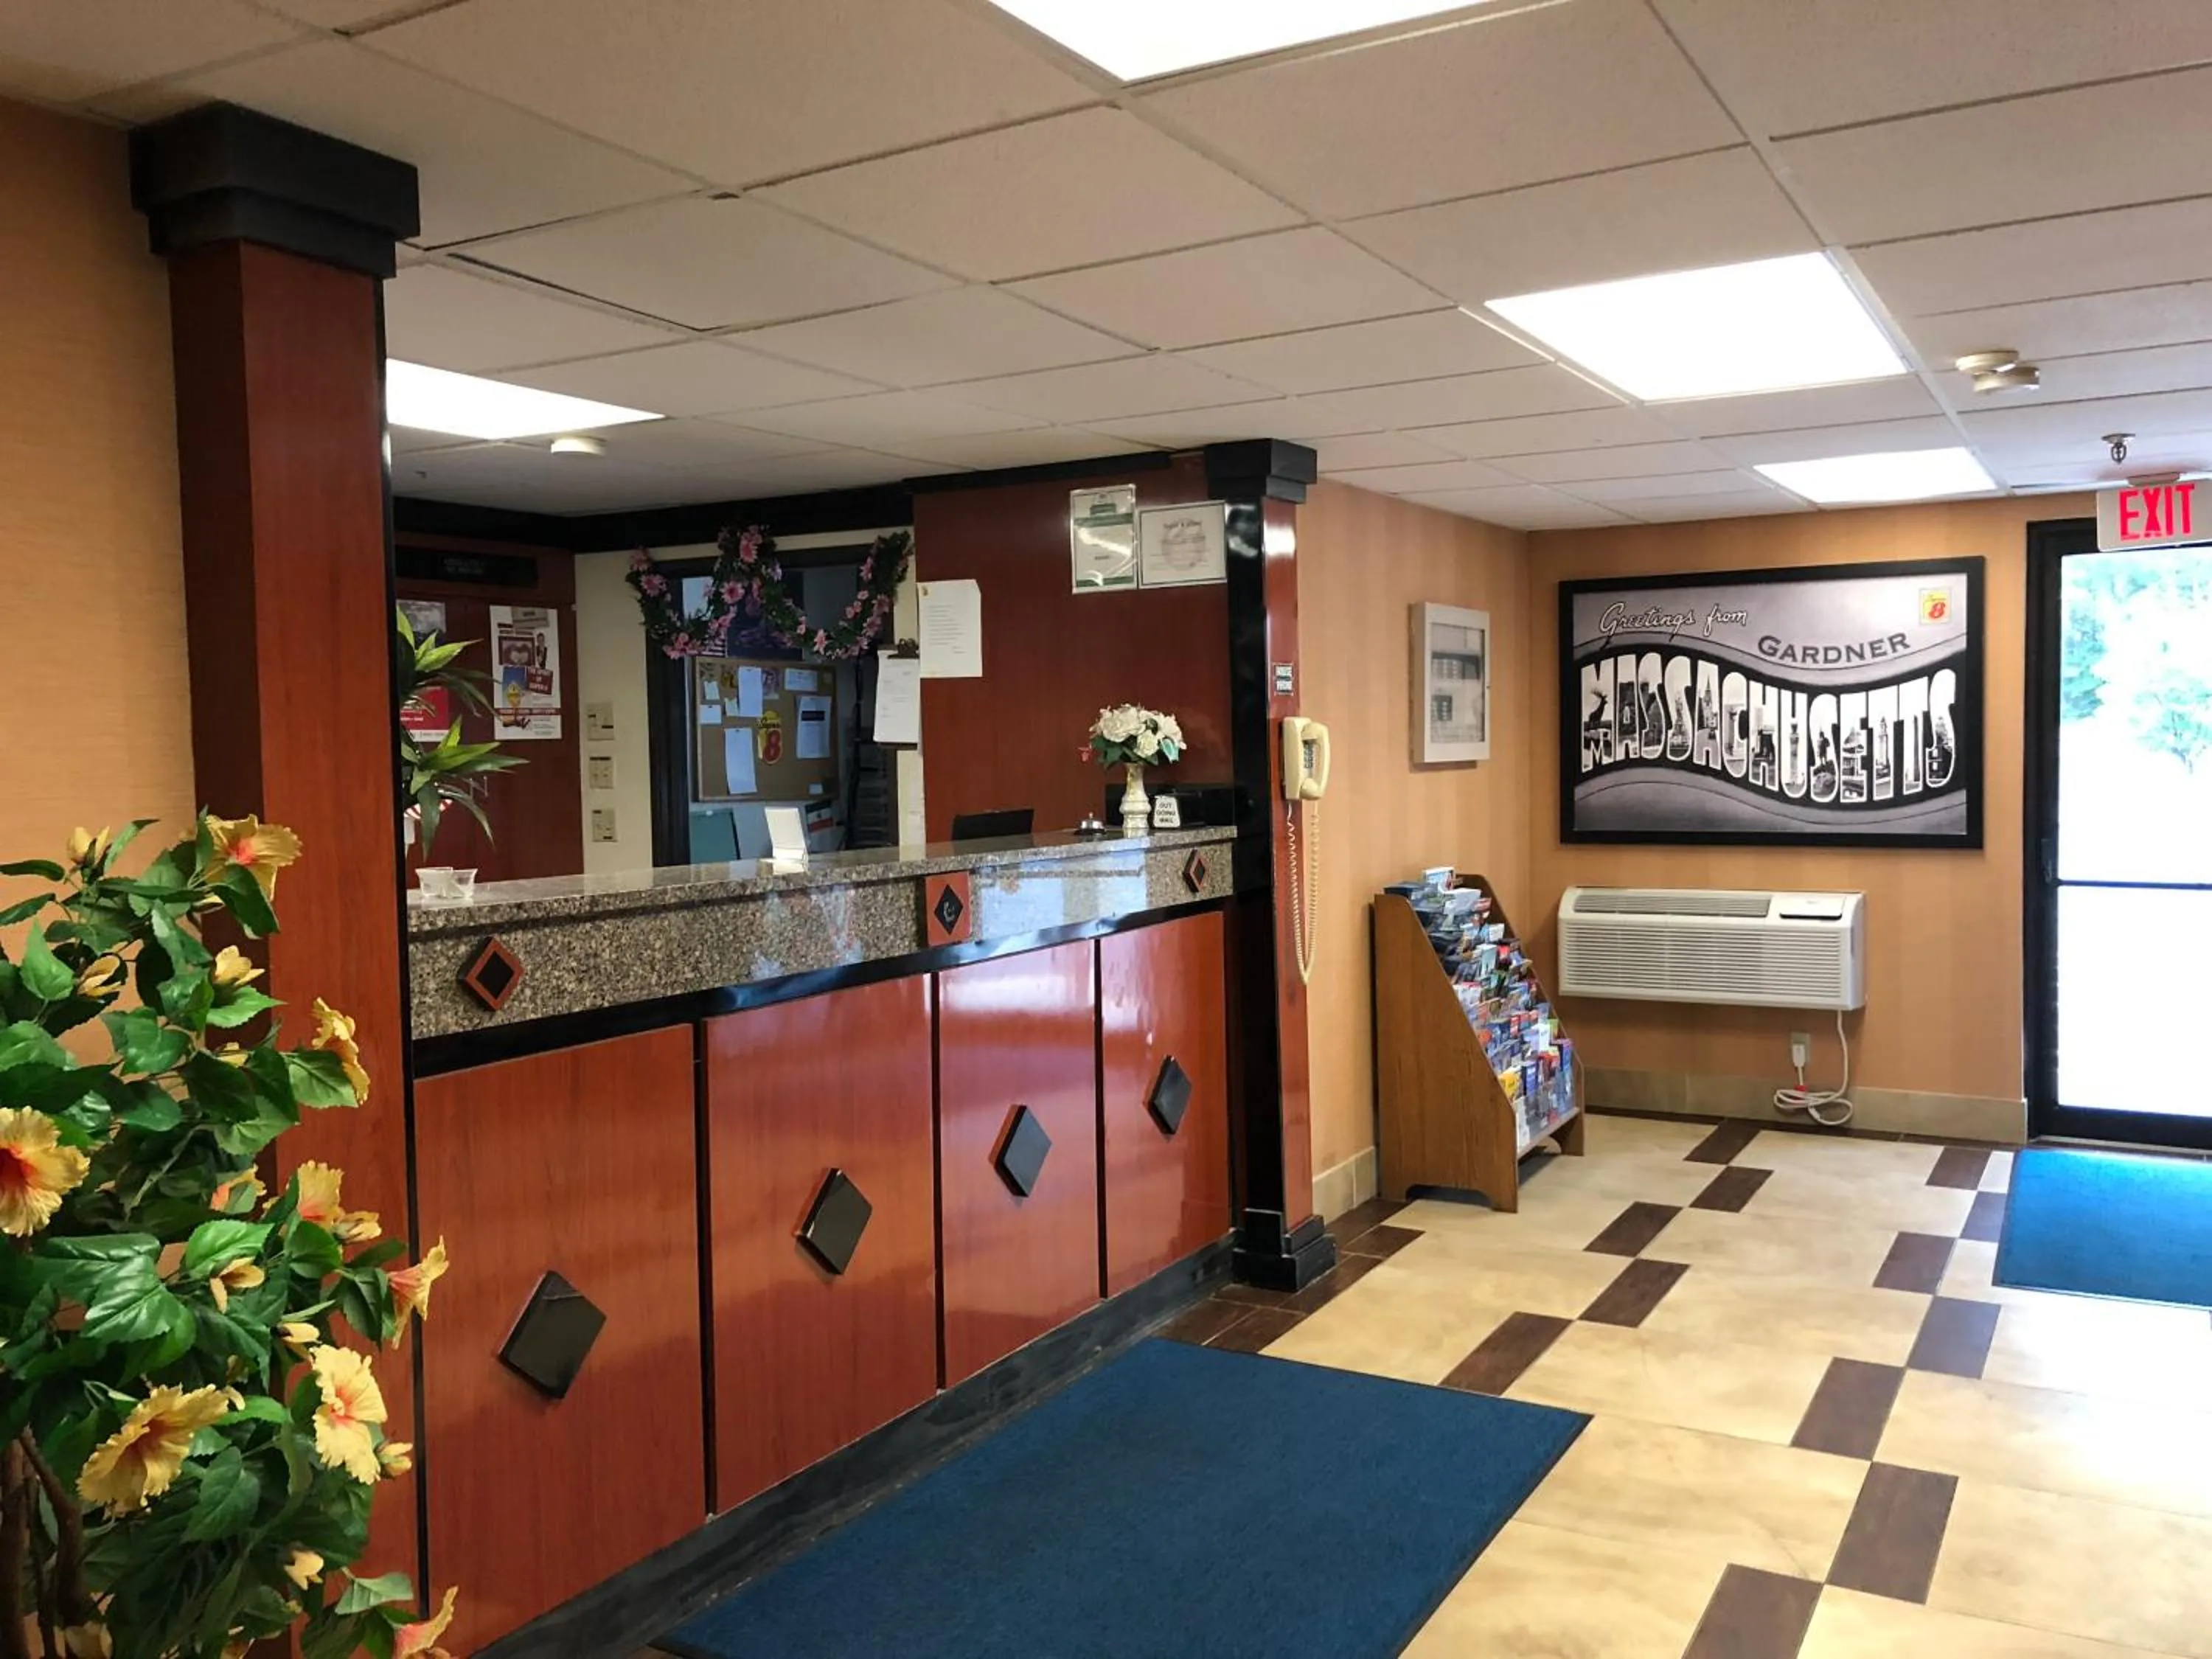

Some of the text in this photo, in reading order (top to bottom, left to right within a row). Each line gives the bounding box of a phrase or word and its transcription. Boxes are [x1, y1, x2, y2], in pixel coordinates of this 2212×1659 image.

[2119, 484, 2195, 542] EXIT
[1599, 601, 1747, 646] Greetings from
[1757, 631, 1911, 664] GARDNER
[763, 728, 783, 765] 8
[1580, 652, 1957, 804] MASSACHUSETTS
